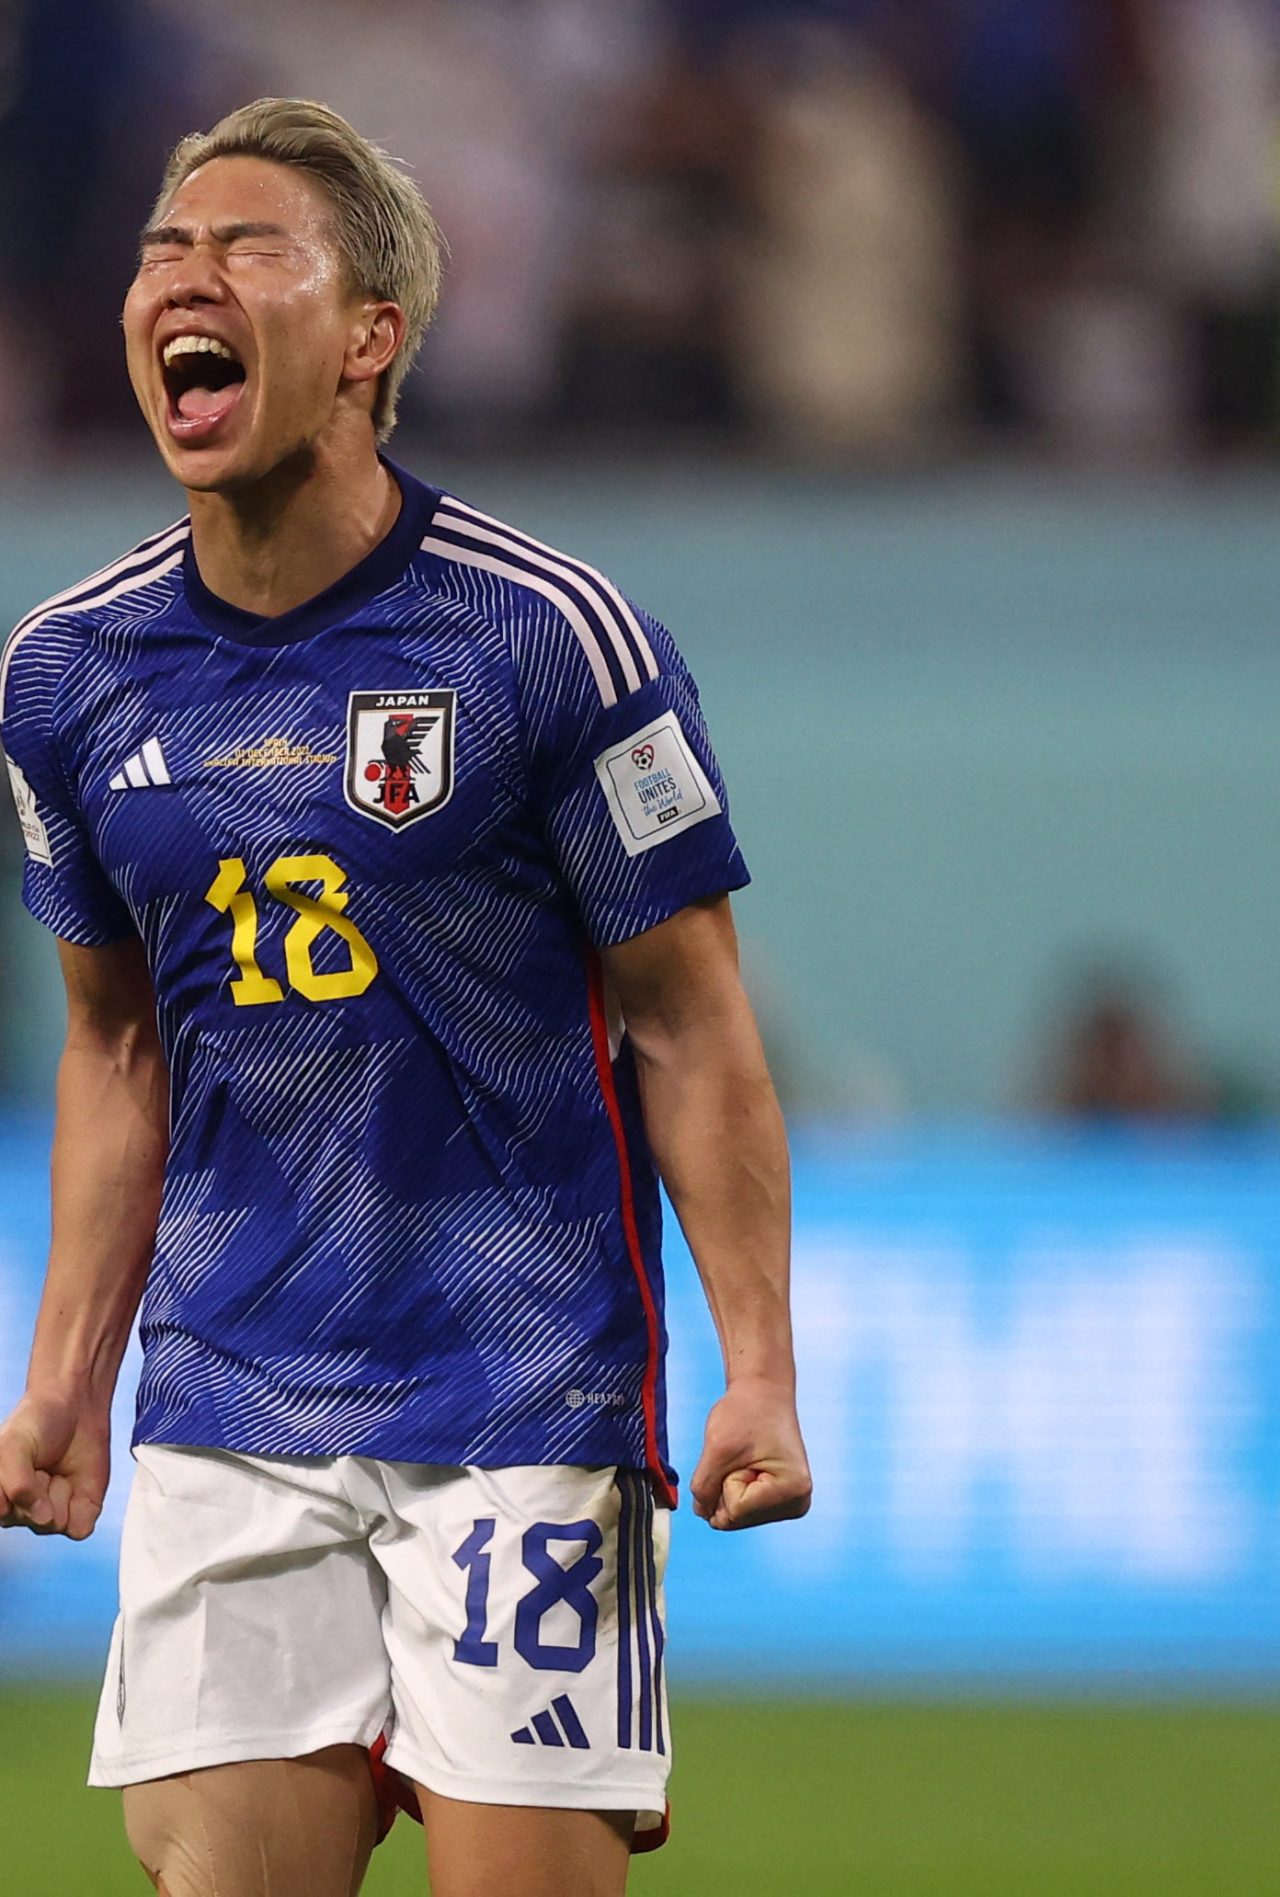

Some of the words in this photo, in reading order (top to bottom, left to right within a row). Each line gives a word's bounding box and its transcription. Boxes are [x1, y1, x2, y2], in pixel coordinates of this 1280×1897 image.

[376, 695, 429, 707] JAPAN
[634, 768, 671, 791] FOOTBALL
[638, 777, 677, 804] UNITES
[373, 783, 420, 804] JFA
[656, 788, 683, 809] World
[204, 854, 379, 1006] 18
[451, 1518, 603, 1673] 18
